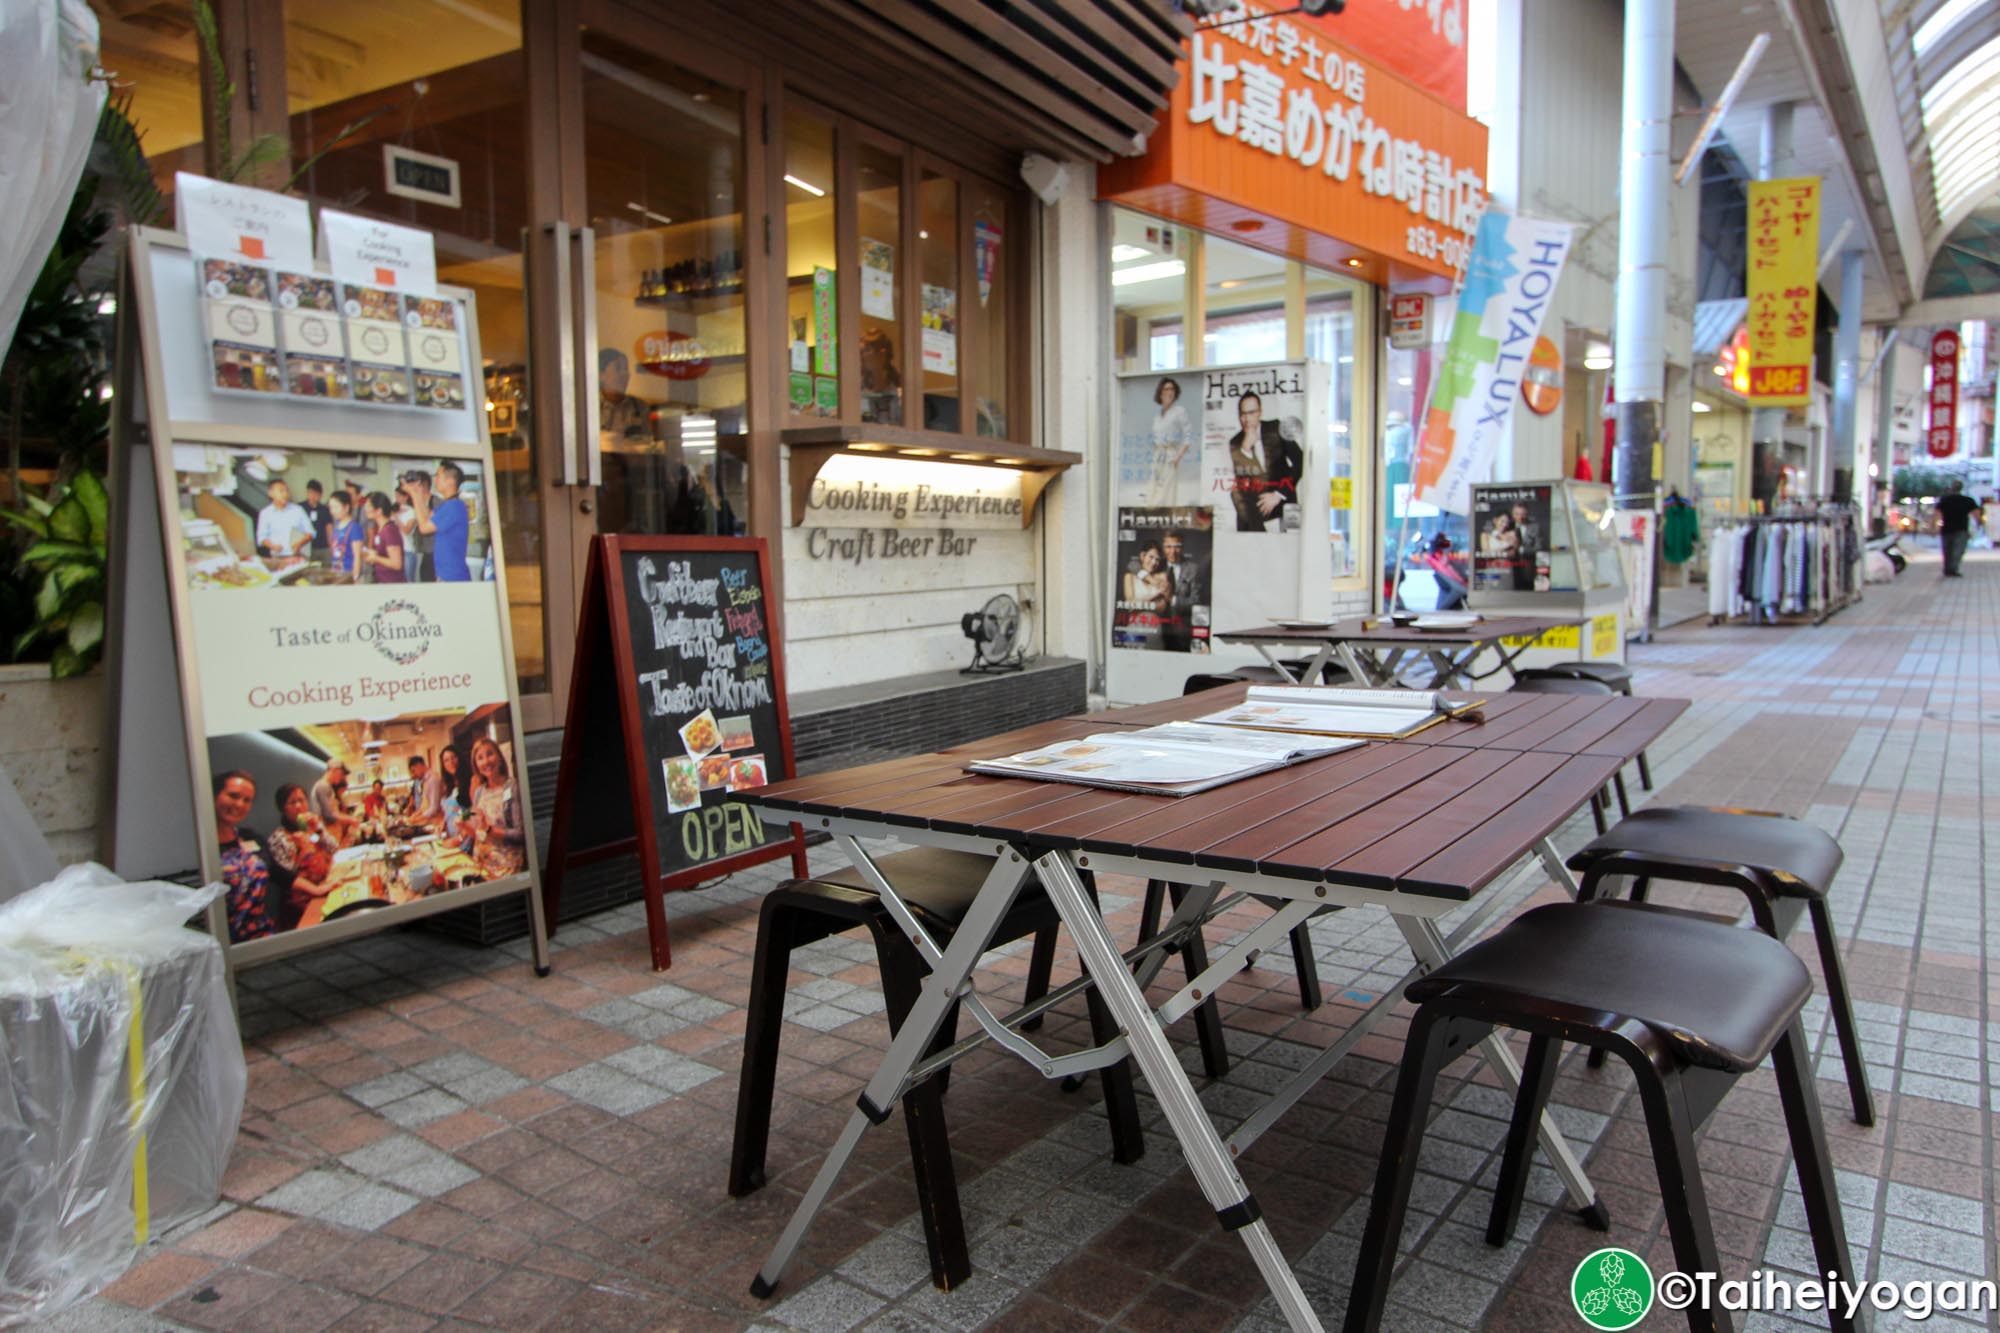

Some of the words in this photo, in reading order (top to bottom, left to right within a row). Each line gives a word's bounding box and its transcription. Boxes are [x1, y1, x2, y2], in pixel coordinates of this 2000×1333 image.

[1187, 31, 1487, 237] 比嘉めがね時計店
[356, 250, 412, 269] Experience
[362, 238, 402, 257] Cooking
[1477, 239, 1564, 428] HOYALUX
[1205, 369, 1304, 399] Hazuki
[1932, 361, 1954, 450] 沖縄銀行
[806, 478, 909, 520] Cooking
[914, 484, 1022, 520] Experience
[1120, 510, 1193, 527] Hazuki
[807, 526, 874, 566] Craft
[880, 527, 934, 559] Beer
[937, 527, 977, 557] Bar
[270, 626, 332, 648] Taste
[337, 628, 352, 644] of
[356, 621, 443, 643] Okinawa
[248, 681, 354, 708] Cooking
[359, 670, 472, 701] Experience
[638, 668, 696, 716] Taste
[682, 802, 765, 860] OPEN
